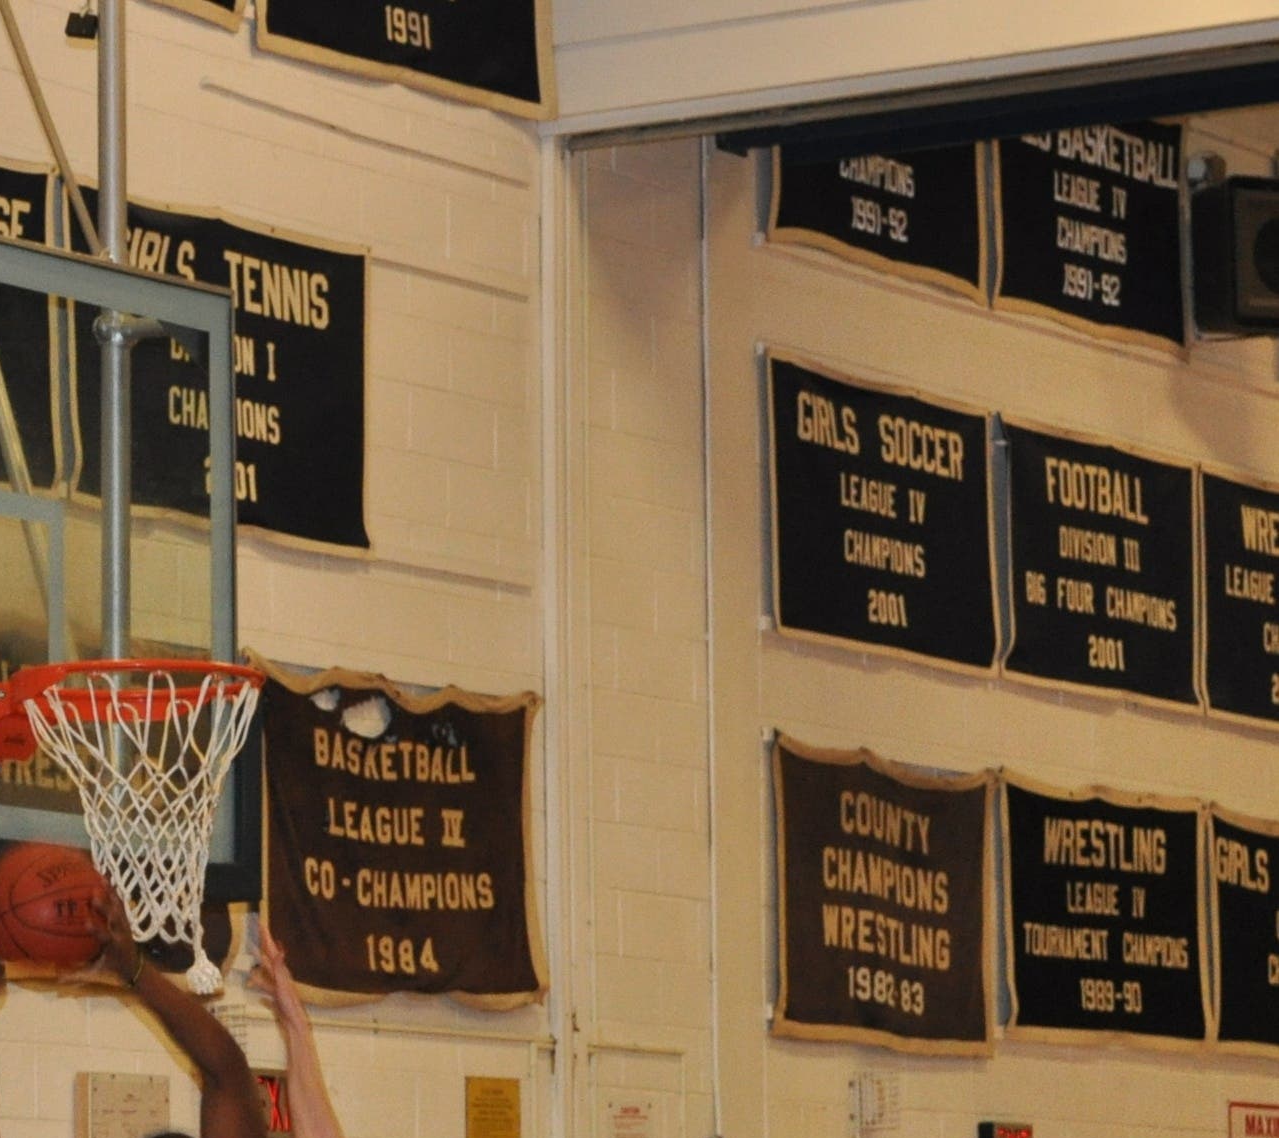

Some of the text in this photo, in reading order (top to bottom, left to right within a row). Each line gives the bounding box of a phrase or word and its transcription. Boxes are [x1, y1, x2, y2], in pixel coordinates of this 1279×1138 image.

[385, 4, 431, 50] 1991
[1057, 121, 1179, 189] BASKETBALL
[1056, 215, 1128, 266] CHAMPIONS
[124, 226, 330, 330] IRLS TENNIS
[169, 386, 281, 445] CHAIONS
[796, 390, 964, 482] GIRLS SOCCER
[839, 470, 926, 525] LEAGUE IV
[1044, 456, 1150, 526] FOOTBALL
[844, 528, 927, 578] CHAMPIONS
[1058, 524, 1117, 567] DIVISION
[866, 588, 909, 629] 2001
[1025, 570, 1178, 632] BIG FOUR CHAMPIONS
[1224, 563, 1276, 605] LEAGUE
[1088, 633, 1126, 672] 2001
[313, 726, 475, 784] BASKETBALL
[328, 797, 465, 848] LEAGUE IV
[840, 790, 930, 856] COUNTY
[1043, 815, 1167, 875] WRESTLING
[823, 845, 949, 914] CHAMPIONS
[1216, 835, 1270, 894] GIRLS
[1066, 880, 1120, 917] LEAGUE
[366, 933, 440, 975] 1984
[822, 902, 951, 971] WRESTLING
[1023, 921, 1189, 971] TOURNAMENT CHAMPIONS
